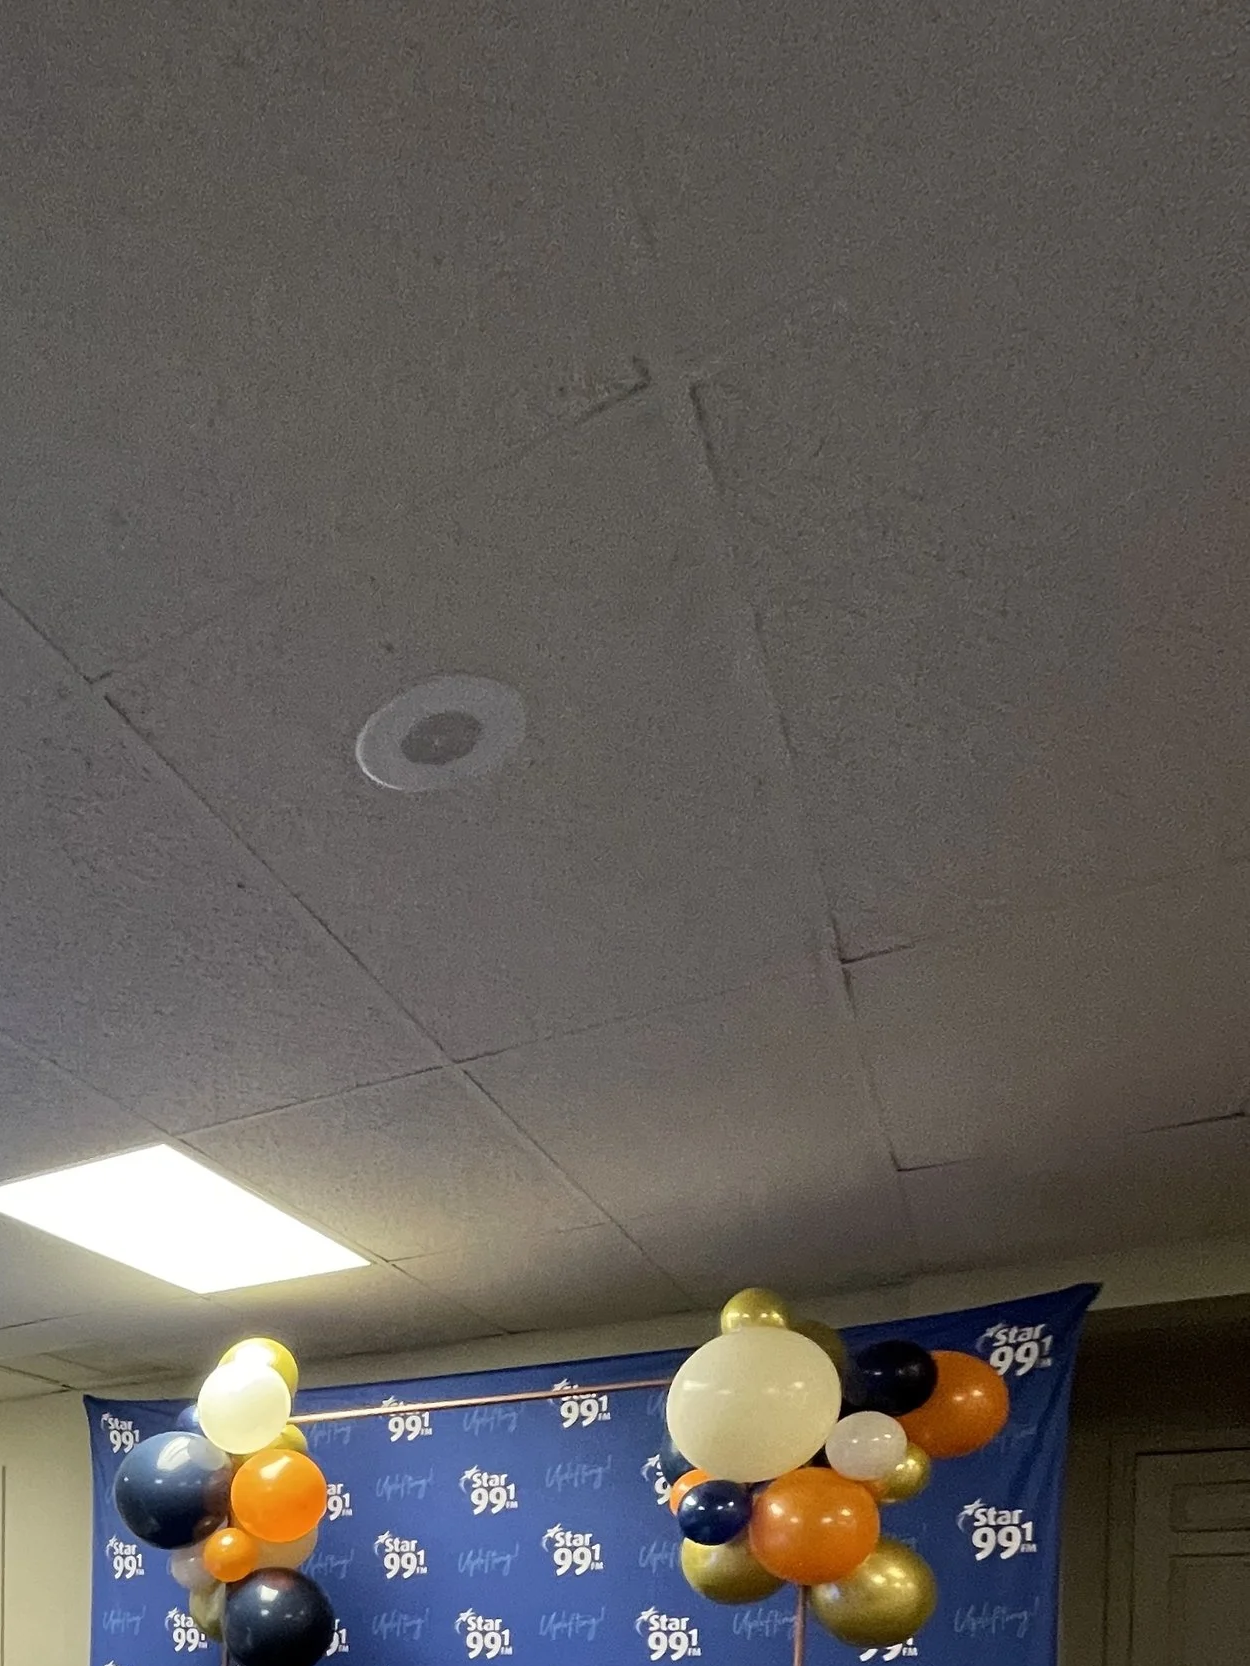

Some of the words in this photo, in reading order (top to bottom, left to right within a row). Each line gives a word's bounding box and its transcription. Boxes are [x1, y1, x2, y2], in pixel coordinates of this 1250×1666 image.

[993, 1324, 1046, 1346] Star
[990, 1335, 1053, 1376] 991
[108, 1418, 133, 1430] Star
[560, 1395, 608, 1429] 991
[388, 1412, 430, 1442] 991
[473, 1472, 508, 1488] Star
[327, 1494, 350, 1521] 91
[471, 1484, 516, 1515] 991
[974, 1507, 1023, 1526] Star
[114, 1542, 137, 1555] Star
[385, 1538, 417, 1552] Star
[554, 1532, 593, 1547] Star
[972, 1521, 1033, 1561] 991
[113, 1554, 142, 1579] 991
[384, 1550, 425, 1579] 991
[553, 1544, 601, 1576] 991
[173, 1615, 196, 1627] Sta
[467, 1615, 502, 1631] Star
[649, 1614, 689, 1630] Star
[466, 1629, 510, 1659] 991
[648, 1629, 698, 1661] 991
